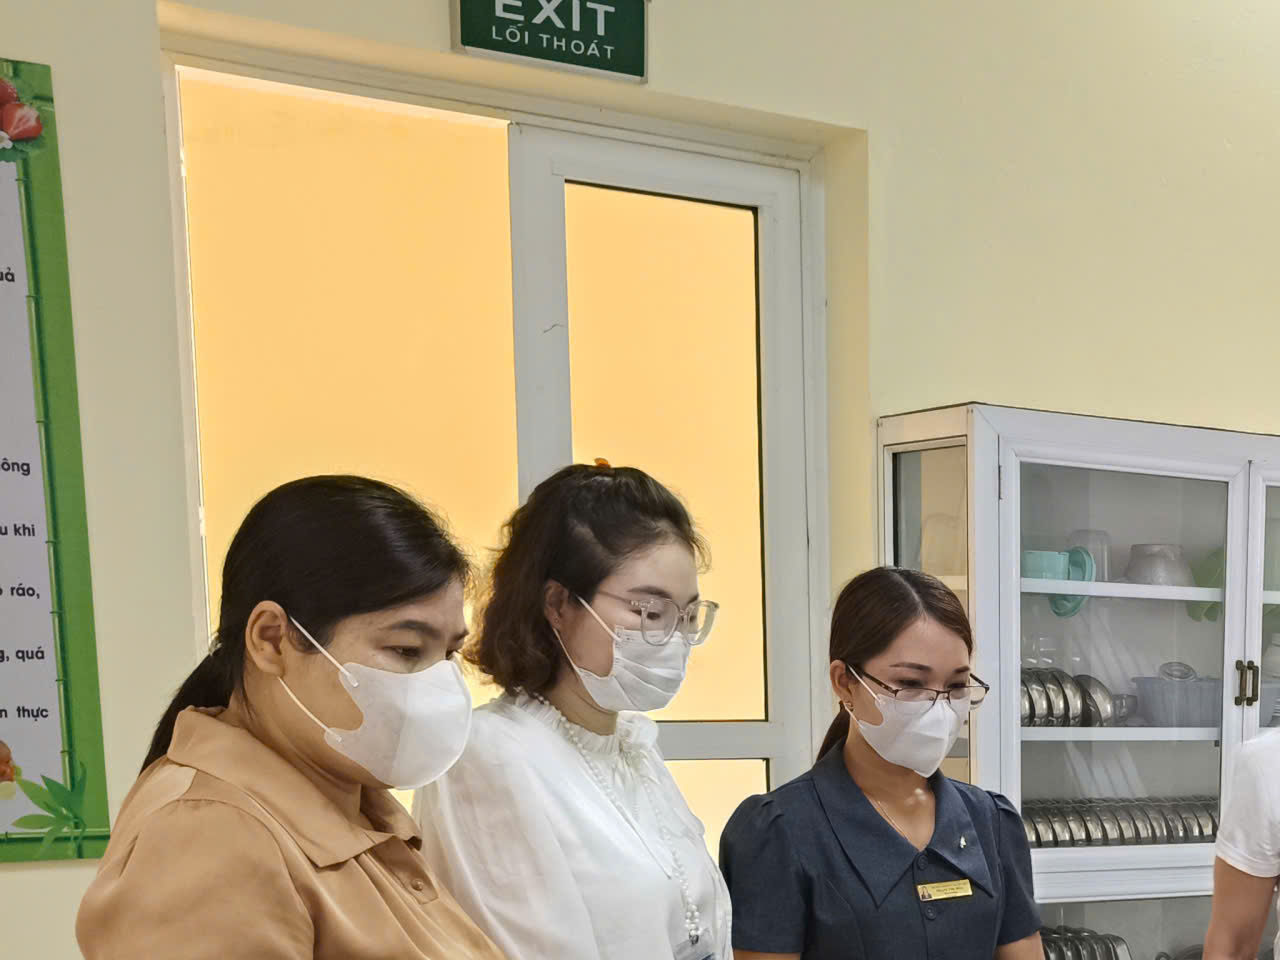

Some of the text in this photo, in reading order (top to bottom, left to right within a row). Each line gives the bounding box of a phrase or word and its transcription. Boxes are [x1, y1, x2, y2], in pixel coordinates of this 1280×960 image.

[495, 0, 616, 36] EXIT
[492, 23, 615, 59] LỐI THOÁT
[1, 457, 30, 476] ông
[13, 524, 36, 537] khi
[10, 583, 40, 599] ráo,
[15, 646, 45, 662] quá
[16, 706, 49, 722] thực
